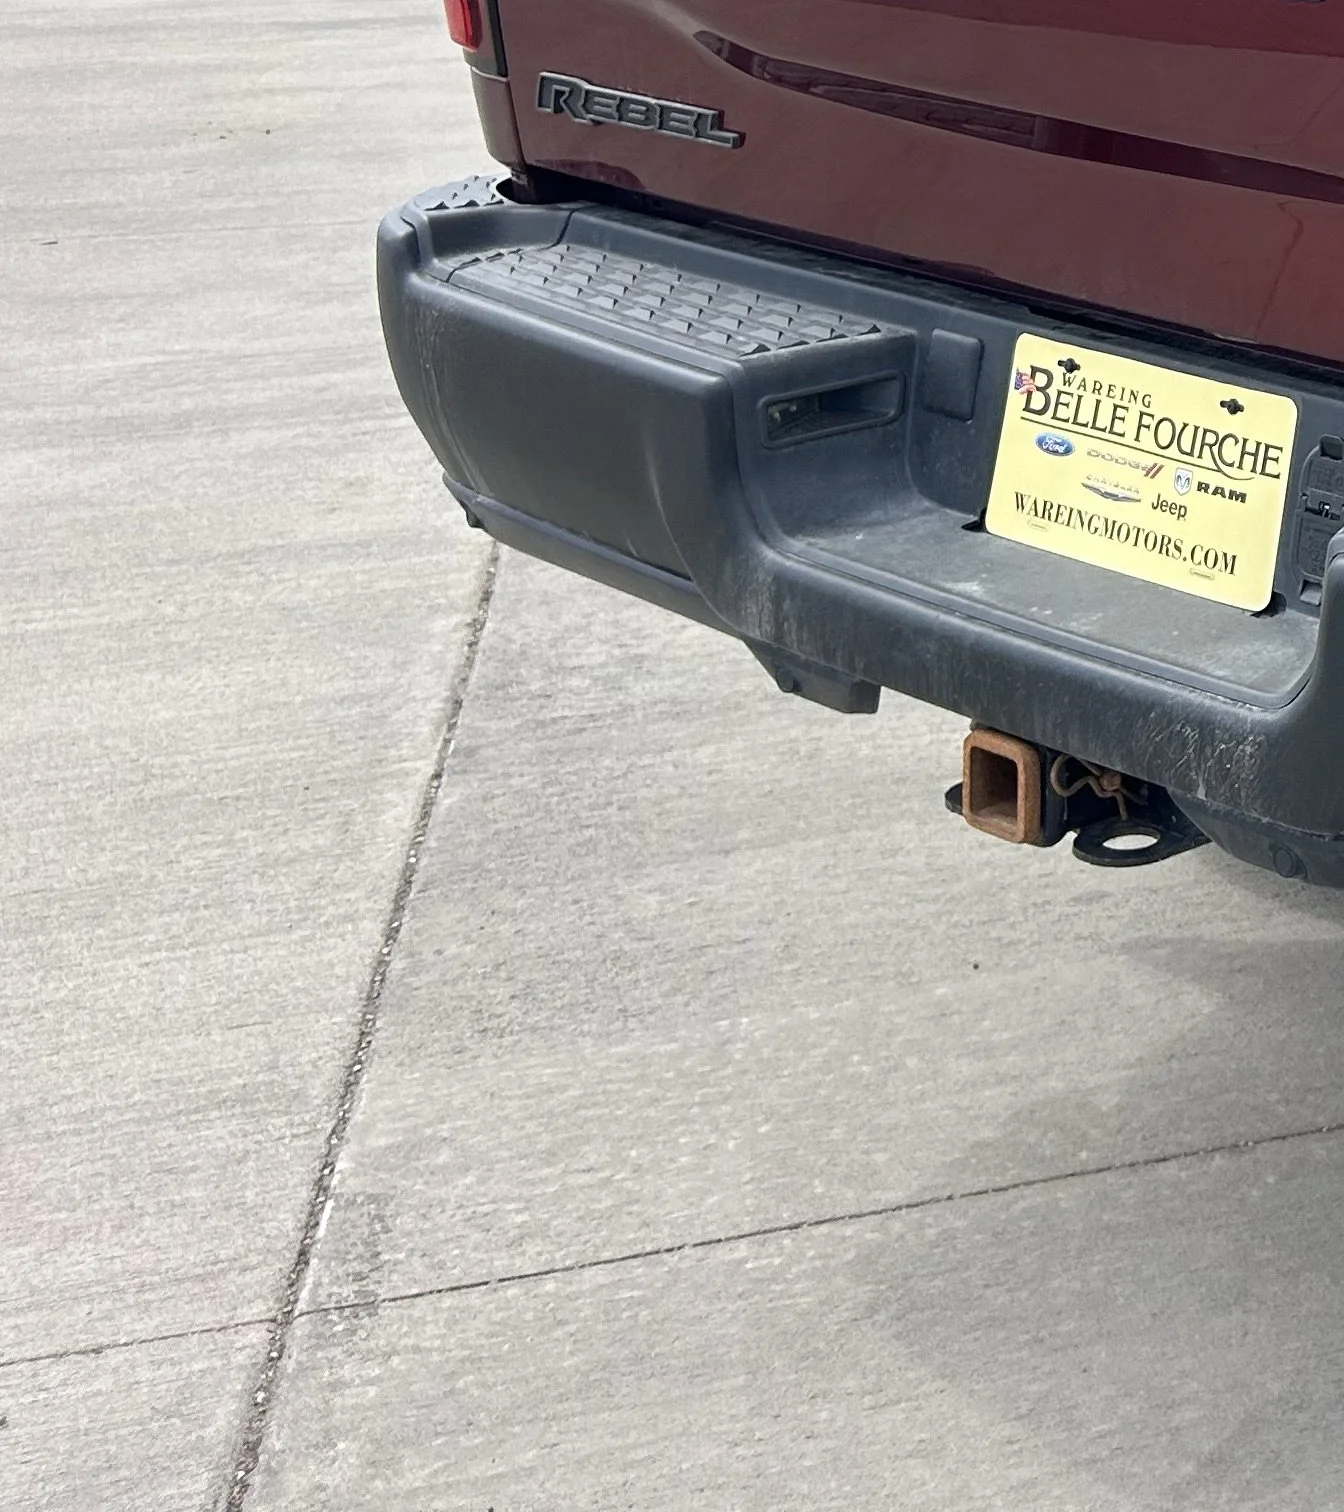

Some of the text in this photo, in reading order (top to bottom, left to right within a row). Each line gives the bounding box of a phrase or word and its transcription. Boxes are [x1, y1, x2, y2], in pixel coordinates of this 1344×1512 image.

[536, 71, 745, 148] REBEL
[1062, 372, 1152, 408] WAREING
[1022, 364, 1284, 480] BELLE FOURCHE
[1040, 435, 1069, 454] Ford
[1151, 492, 1188, 521] Jeep
[1197, 480, 1248, 504] RAM
[1014, 491, 1238, 576] WAREINGMOTORS.COM
